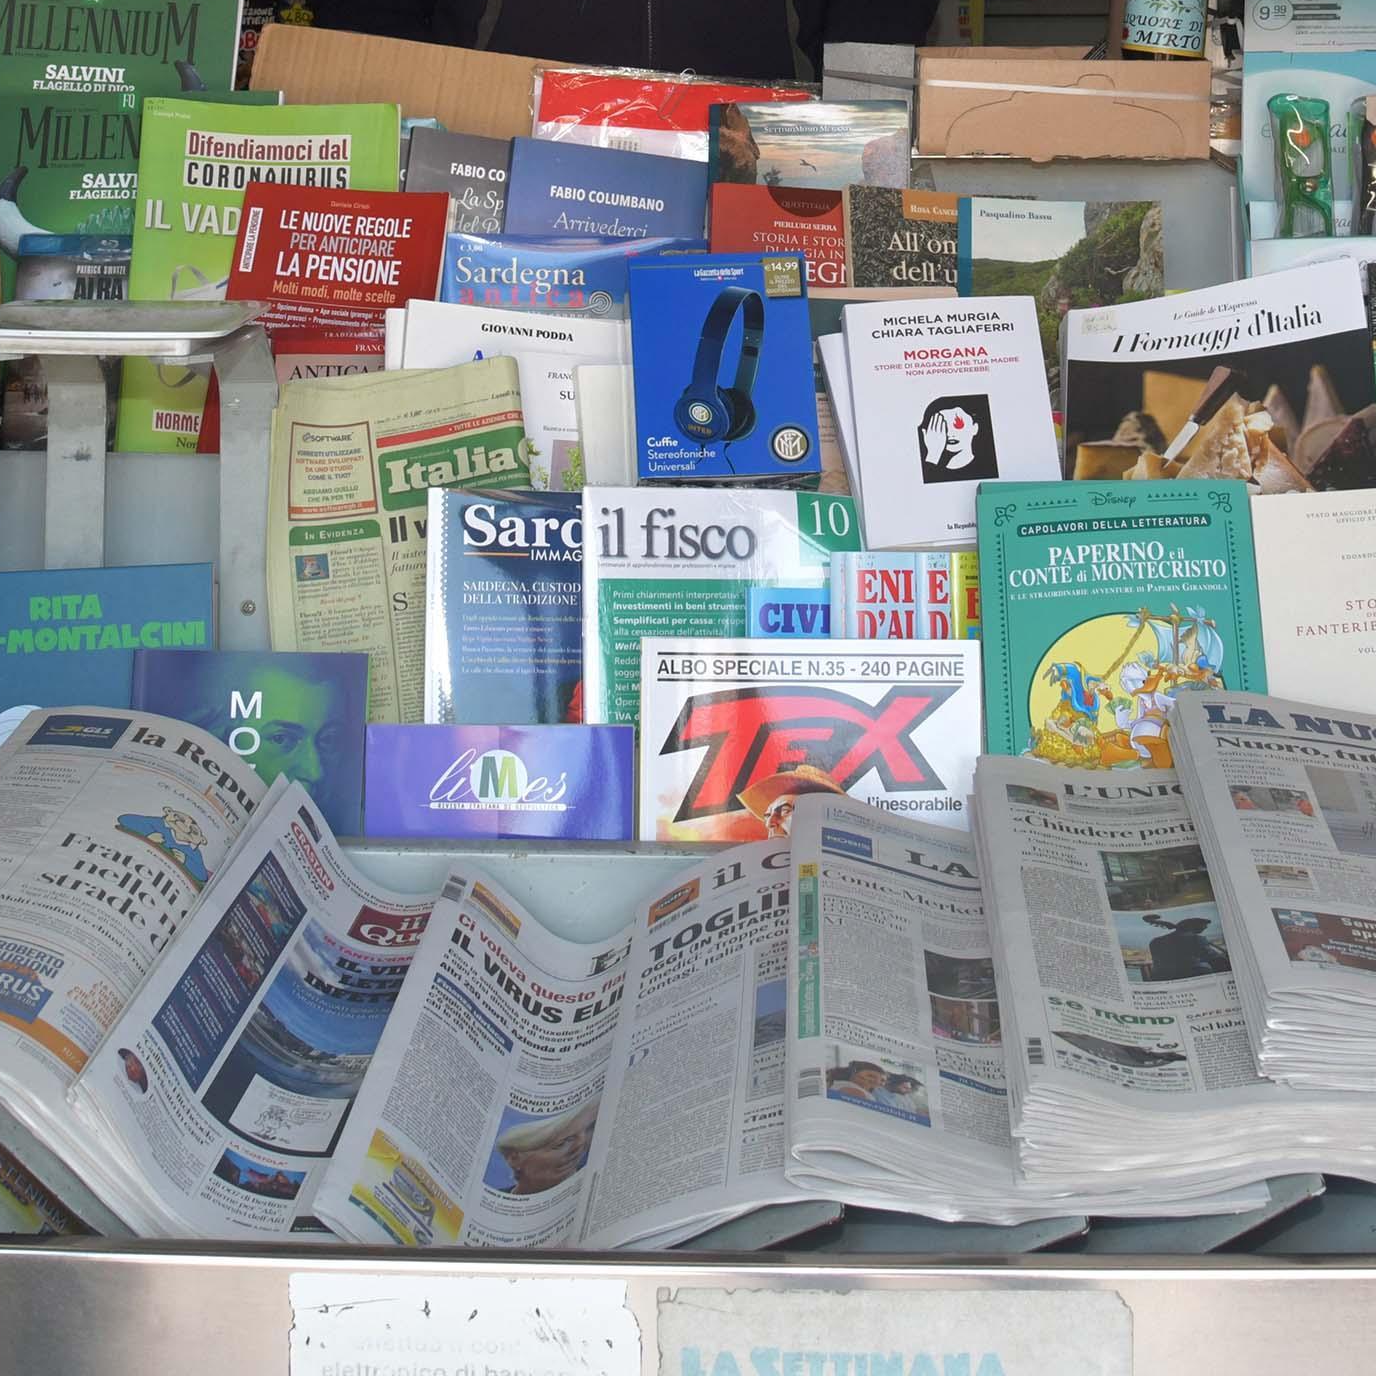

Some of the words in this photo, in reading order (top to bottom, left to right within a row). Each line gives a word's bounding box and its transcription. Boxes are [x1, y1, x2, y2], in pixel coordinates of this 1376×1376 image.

[1134, 29, 1201, 51] MIRTO
[279, 210, 297, 232] LE
[302, 211, 350, 234] NUOVE
[354, 215, 411, 239] REGOLE
[290, 232, 315, 251] PER
[319, 234, 395, 258] ANTICIPARE
[276, 252, 296, 278] LA
[301, 254, 400, 285] PENSIONE
[871, 326, 919, 339] CHIARA
[925, 321, 1014, 336] TAGLIAFERRI
[883, 314, 933, 327] MICHELA
[946, 310, 1000, 323] MURGIA
[903, 345, 988, 360] MORGANA
[599, 506, 622, 557] il
[638, 505, 756, 560] fisco
[1021, 523, 1088, 536] CAPOLAVORI
[1093, 520, 1127, 529] DELLA
[1132, 517, 1208, 527] LETTERATURA
[1048, 541, 1164, 566] PAPERINO
[1169, 551, 1175, 560] e
[1177, 548, 1184, 559] il
[1010, 566, 1072, 587] CONTE
[1077, 570, 1087, 582] di
[1092, 560, 1227, 582] MONTECRISTO
[29, 594, 101, 621] RITA
[1205, 705, 1279, 726] LA
